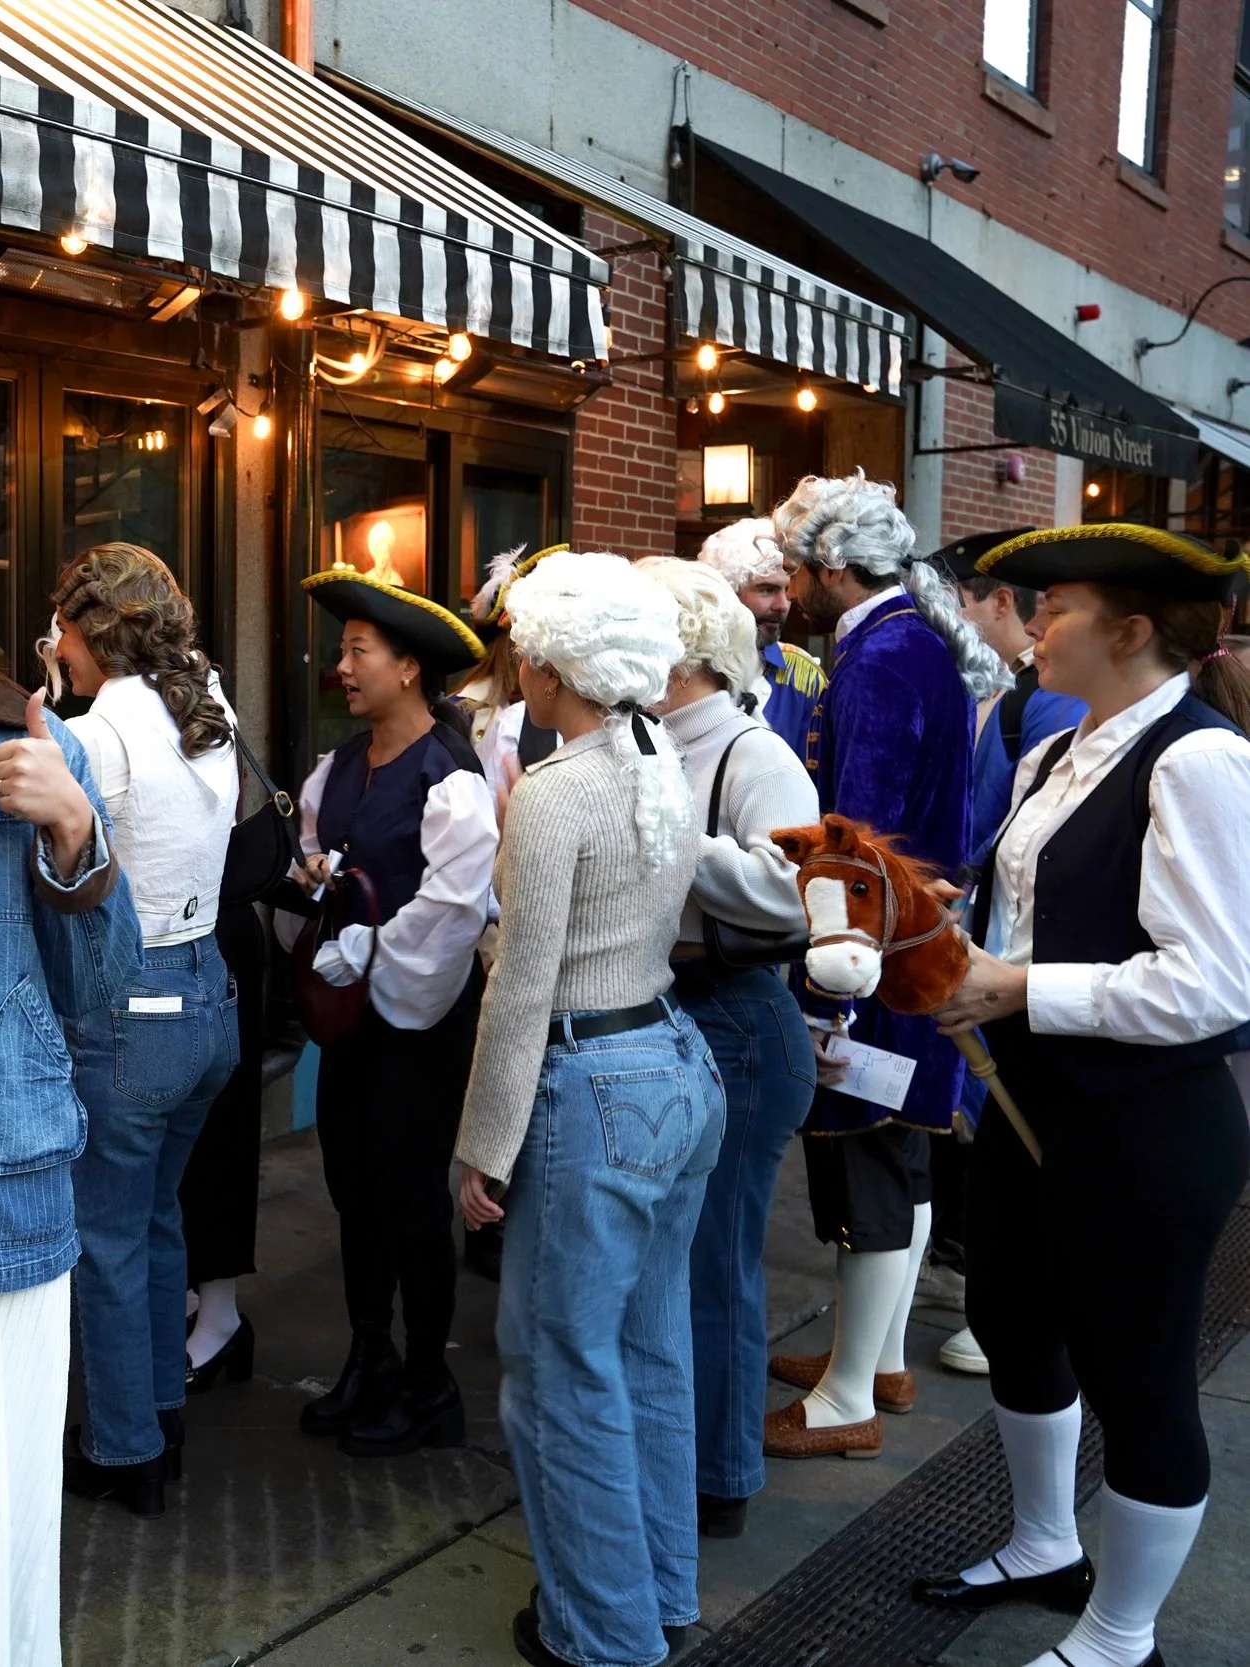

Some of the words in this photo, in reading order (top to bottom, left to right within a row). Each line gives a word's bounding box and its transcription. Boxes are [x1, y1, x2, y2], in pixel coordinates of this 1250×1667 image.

[1050, 409, 1068, 447] 55
[1070, 415, 1111, 458] Union
[1113, 427, 1154, 467] Street
